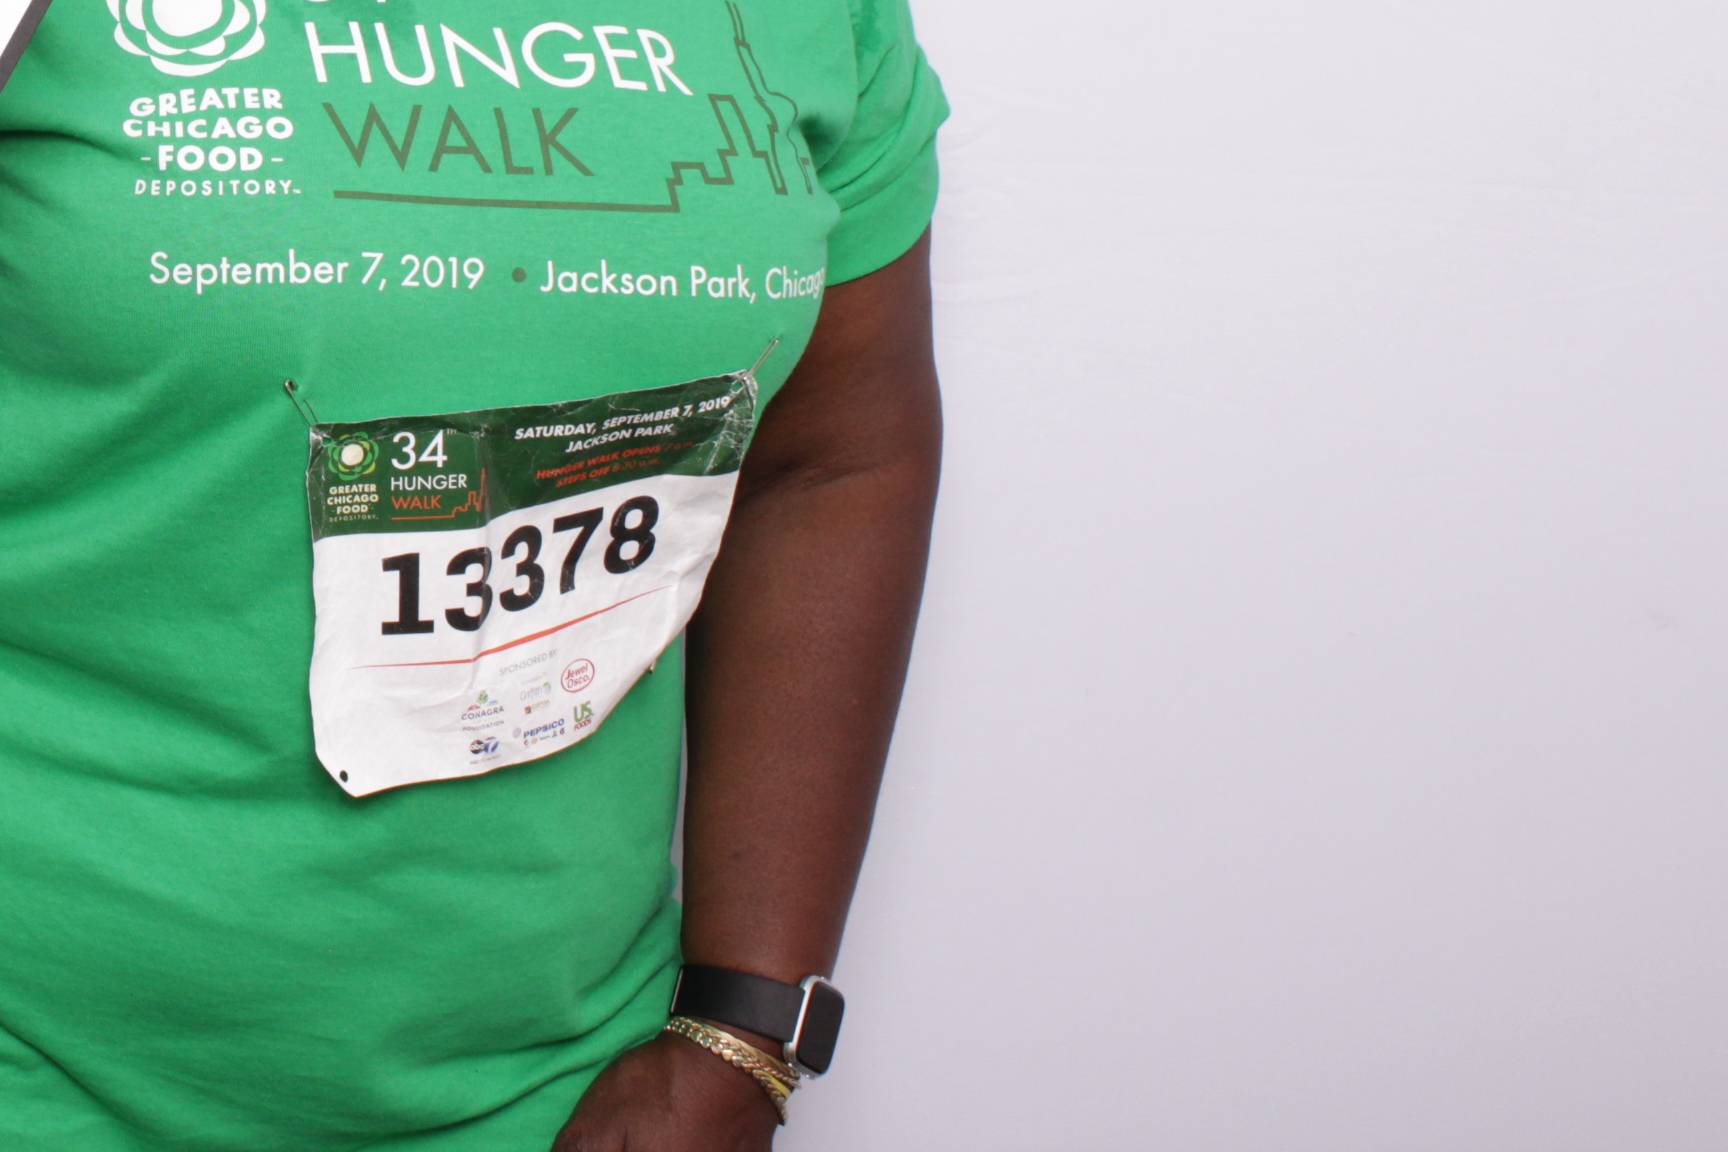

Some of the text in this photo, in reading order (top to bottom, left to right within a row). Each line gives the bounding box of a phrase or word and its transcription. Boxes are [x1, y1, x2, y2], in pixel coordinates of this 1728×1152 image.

[304, 20, 695, 97] HUNGER
[128, 87, 284, 118] GREATER
[122, 115, 295, 140] CHICAGO
[321, 101, 596, 177] WALK
[149, 248, 350, 296] September
[361, 251, 387, 291] 7,
[400, 254, 485, 290] 2019
[539, 259, 678, 297] Jackson
[690, 264, 757, 305] Park,
[514, 396, 731, 440] SATURDAY, SEPTEMBER 7, 2019
[565, 423, 675, 453] JACKSON PARK
[536, 460, 586, 480] HUNGER
[587, 451, 621, 467] WALK
[622, 444, 663, 459] OPENS
[390, 473, 468, 492] HUNGER
[555, 471, 588, 488] STEPS
[588, 465, 612, 479] OFF
[327, 494, 380, 506] CHICAGO
[329, 483, 378, 496] GREATER
[391, 495, 443, 510] WALK
[380, 494, 659, 636] 13378
[499, 651, 548, 677] SPONSORED
[565, 662, 589, 680] Jewel
[461, 705, 505, 721] CONAGRA
[523, 718, 565, 739] PEPSICO
